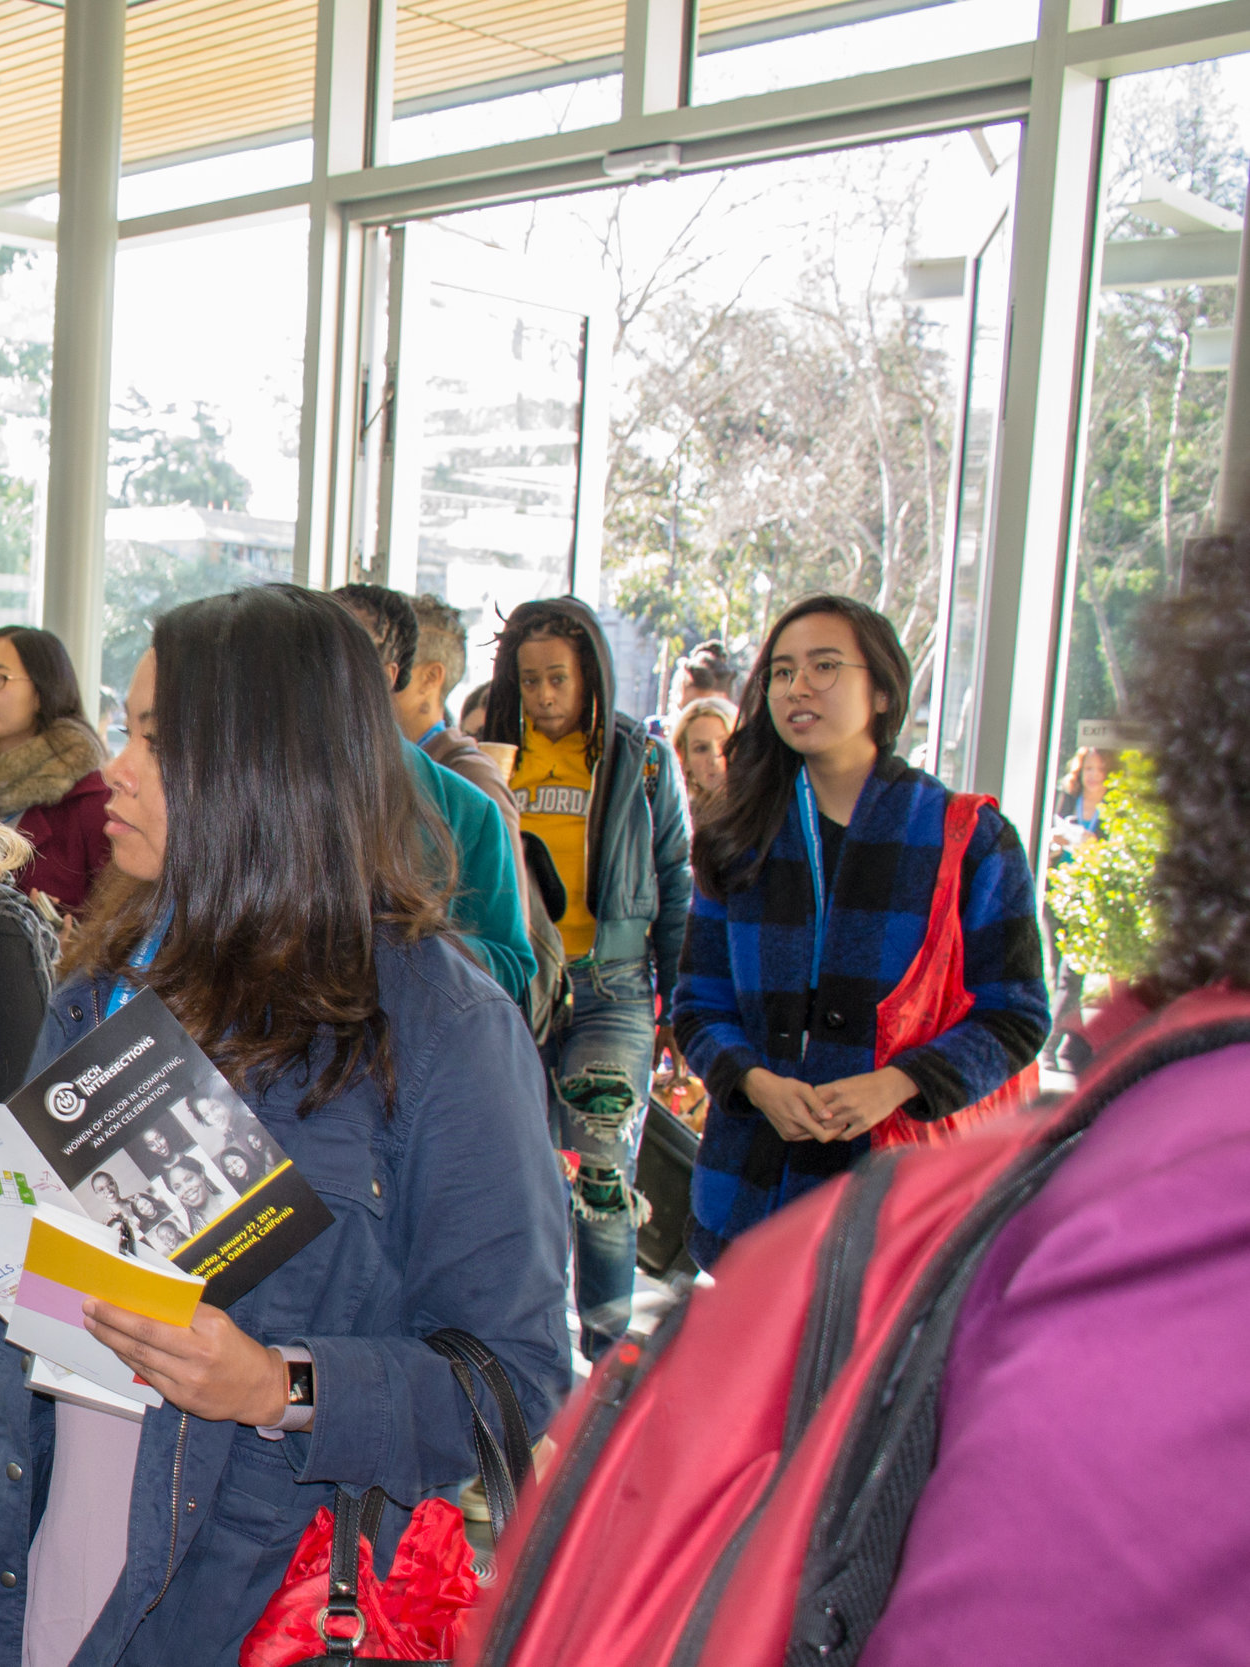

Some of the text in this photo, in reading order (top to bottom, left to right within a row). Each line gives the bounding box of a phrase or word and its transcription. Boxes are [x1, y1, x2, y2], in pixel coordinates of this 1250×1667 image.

[1082, 726, 1107, 736] EXIT
[530, 786, 591, 816] JORD
[75, 1064, 103, 1093] TECH
[84, 1035, 156, 1097] INTERSECTIONS
[62, 1127, 95, 1156] WOMEN
[92, 1118, 104, 1131] OF
[103, 1097, 131, 1123] COLOR
[129, 1090, 139, 1102] IN
[93, 1082, 171, 1149] AN ACM CELEBRATION
[190, 1206, 277, 1277] aturday, January 27, 2018
[203, 1206, 294, 1280] ollege, Oakland, California
